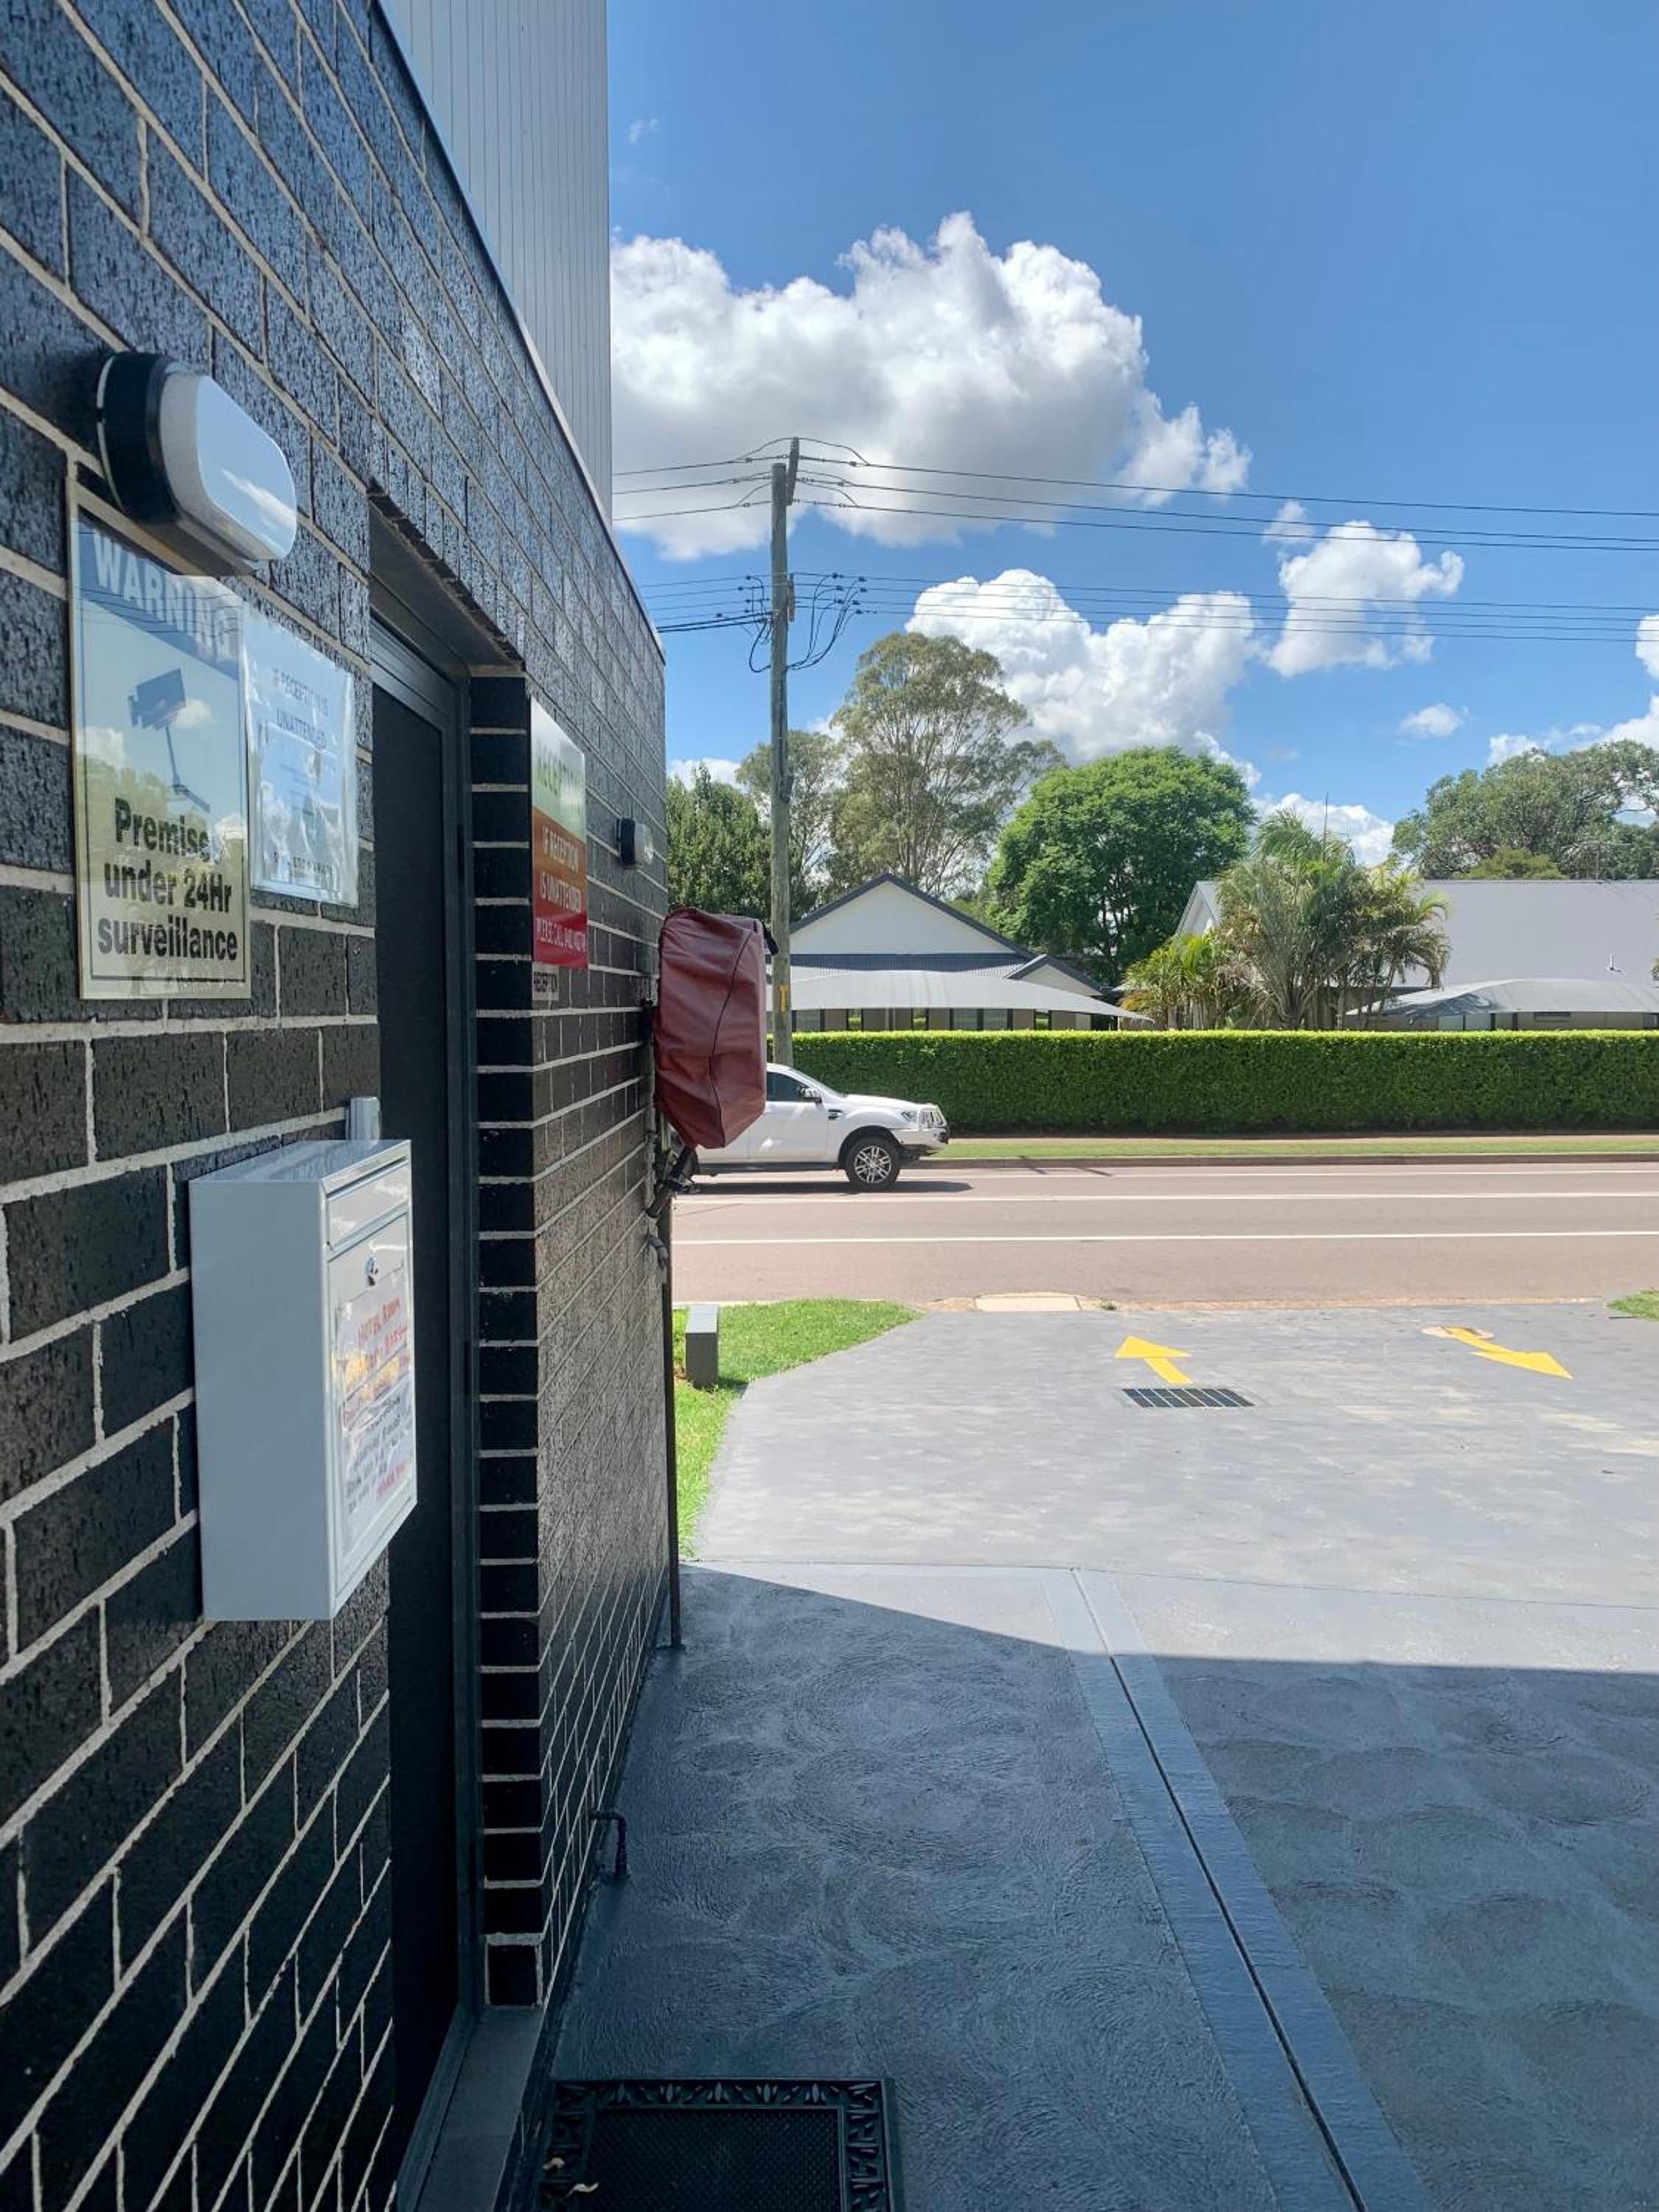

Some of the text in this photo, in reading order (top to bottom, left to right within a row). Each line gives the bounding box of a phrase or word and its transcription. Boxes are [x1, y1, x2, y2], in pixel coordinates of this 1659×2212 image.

[93, 528, 229, 663] WARNING
[104, 859, 233, 914] under 24Hr
[97, 914, 238, 961] surveillance
